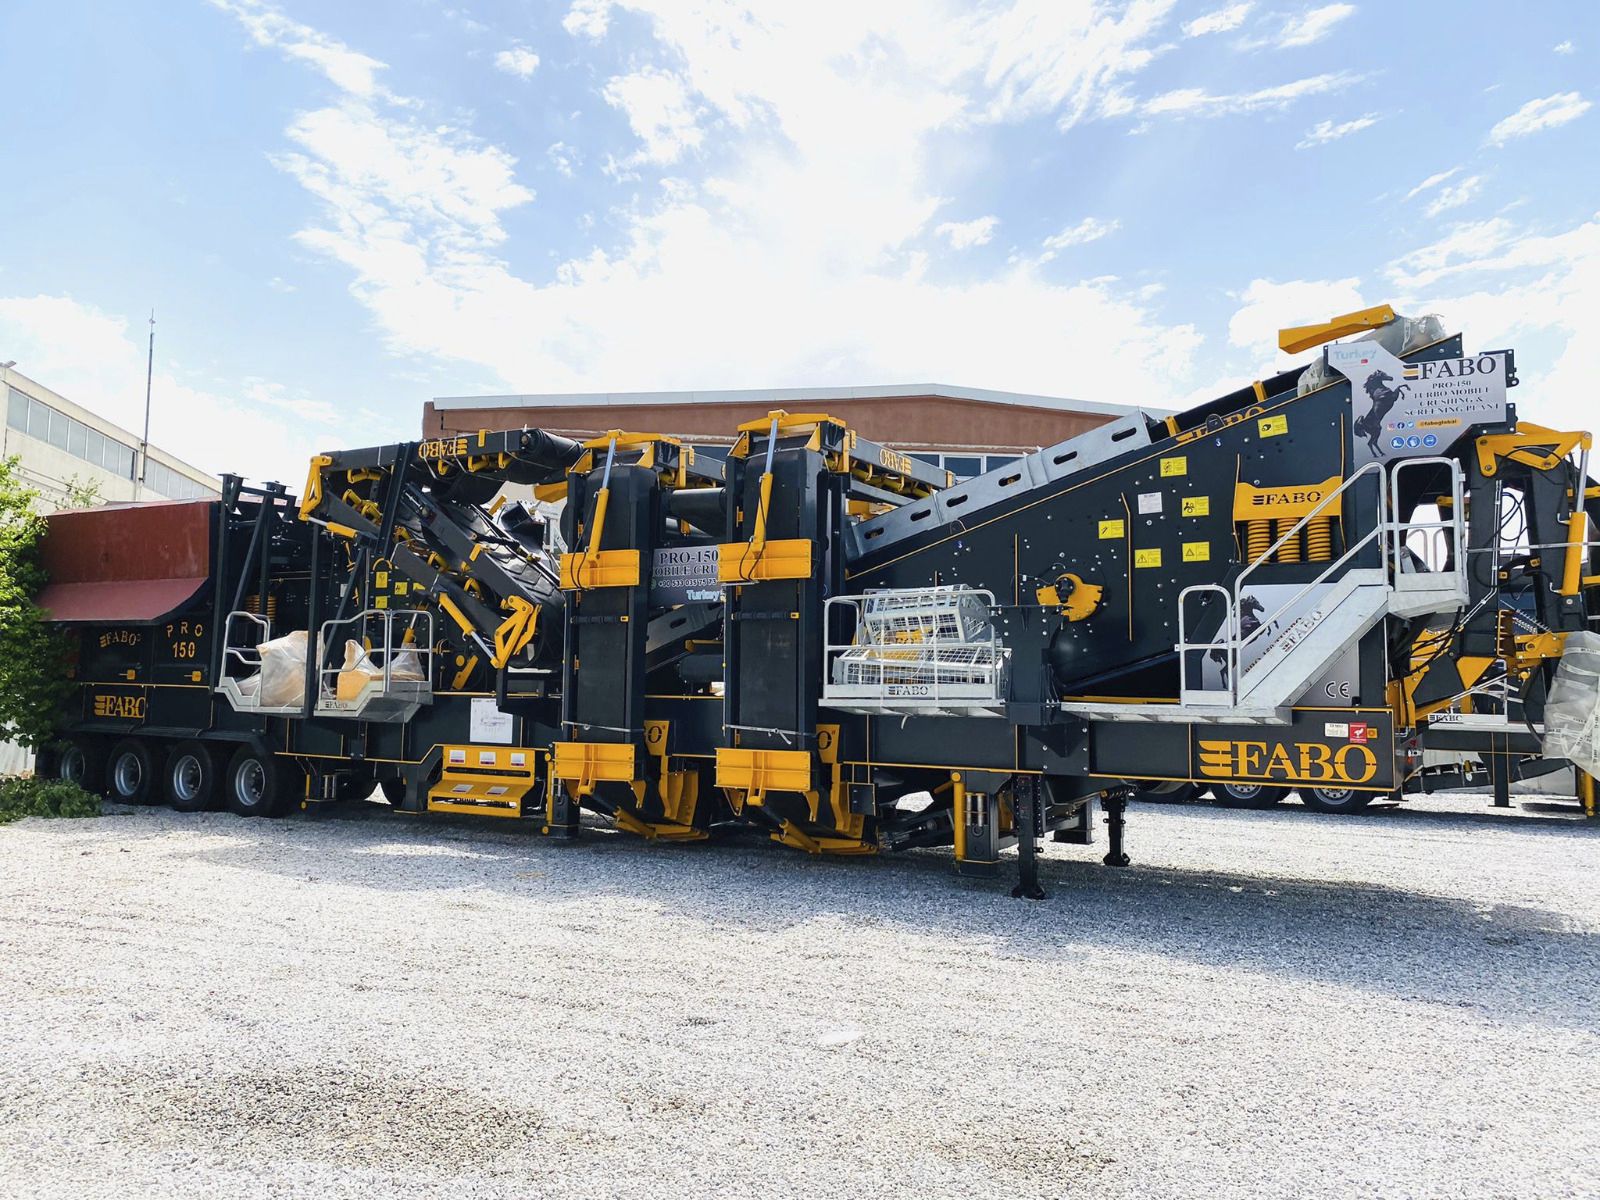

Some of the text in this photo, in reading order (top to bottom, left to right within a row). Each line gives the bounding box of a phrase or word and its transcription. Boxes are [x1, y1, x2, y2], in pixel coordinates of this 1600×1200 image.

[1333, 348, 1377, 360] Turkey
[1420, 356, 1497, 380] FABO
[1432, 380, 1472, 389] PRO-150
[1414, 387, 1489, 399] TURBO MOBILE
[1419, 397, 1473, 407] CRUSHING
[1404, 403, 1499, 416] SCREENING PLANT
[1265, 491, 1321, 505] FABO
[660, 550, 719, 564] PRO-150
[658, 579, 671, 587] +90
[166, 621, 203, 638] PRO
[172, 641, 196, 658] 150
[896, 686, 928, 696] FABO
[1231, 740, 1377, 784] FABO
